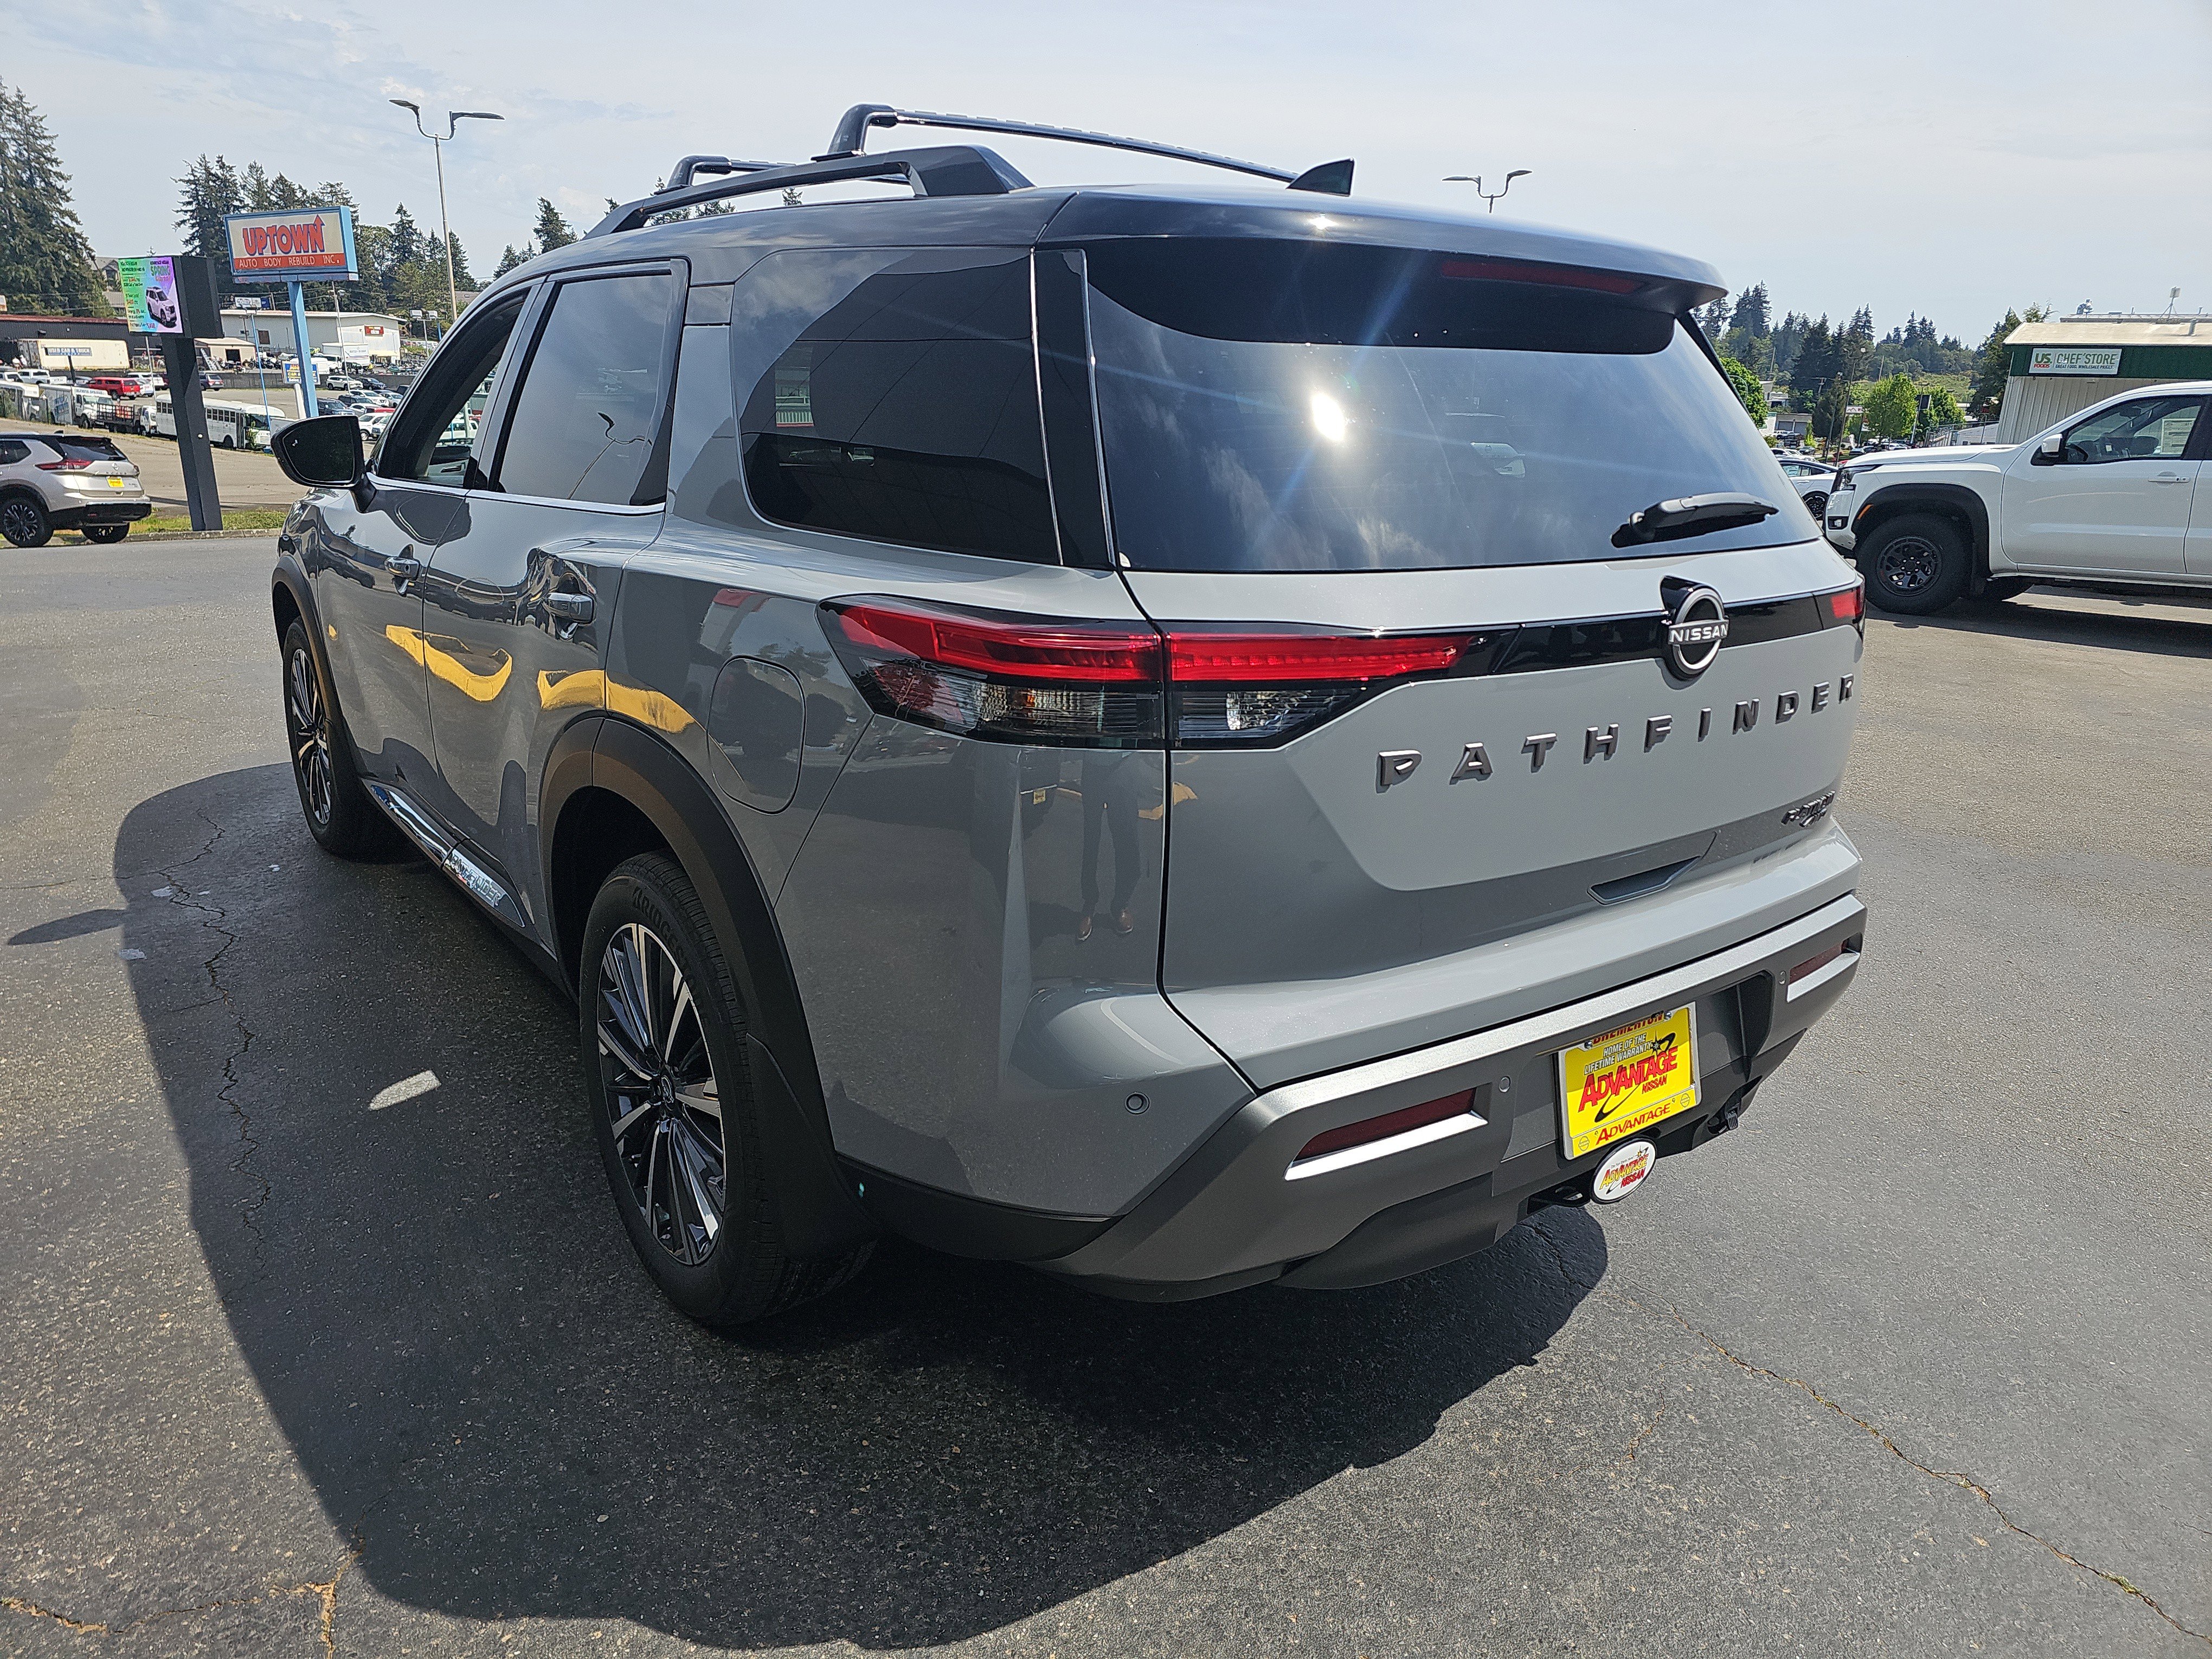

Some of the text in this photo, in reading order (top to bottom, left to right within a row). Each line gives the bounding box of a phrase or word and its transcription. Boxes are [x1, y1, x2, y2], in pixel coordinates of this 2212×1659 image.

[242, 215, 325, 256] UPTOWN
[239, 255, 340, 268] AUTO BODY REBUILD INC.
[1669, 623, 1728, 642] NISSAN
[1377, 673, 1855, 787] PATHFINDER
[1584, 1040, 1652, 1075] LIFETIME WARRANTY
[1603, 1032, 1647, 1057] HOME OF THE
[1578, 1046, 1679, 1113] ADVANTAGE
[1642, 1074, 1668, 1094] NISSAN
[1595, 1103, 1670, 1146] ADVANTAGE
[1599, 1153, 1649, 1190] ADVANTAGE
[1621, 1167, 1646, 1188] NISSAN
